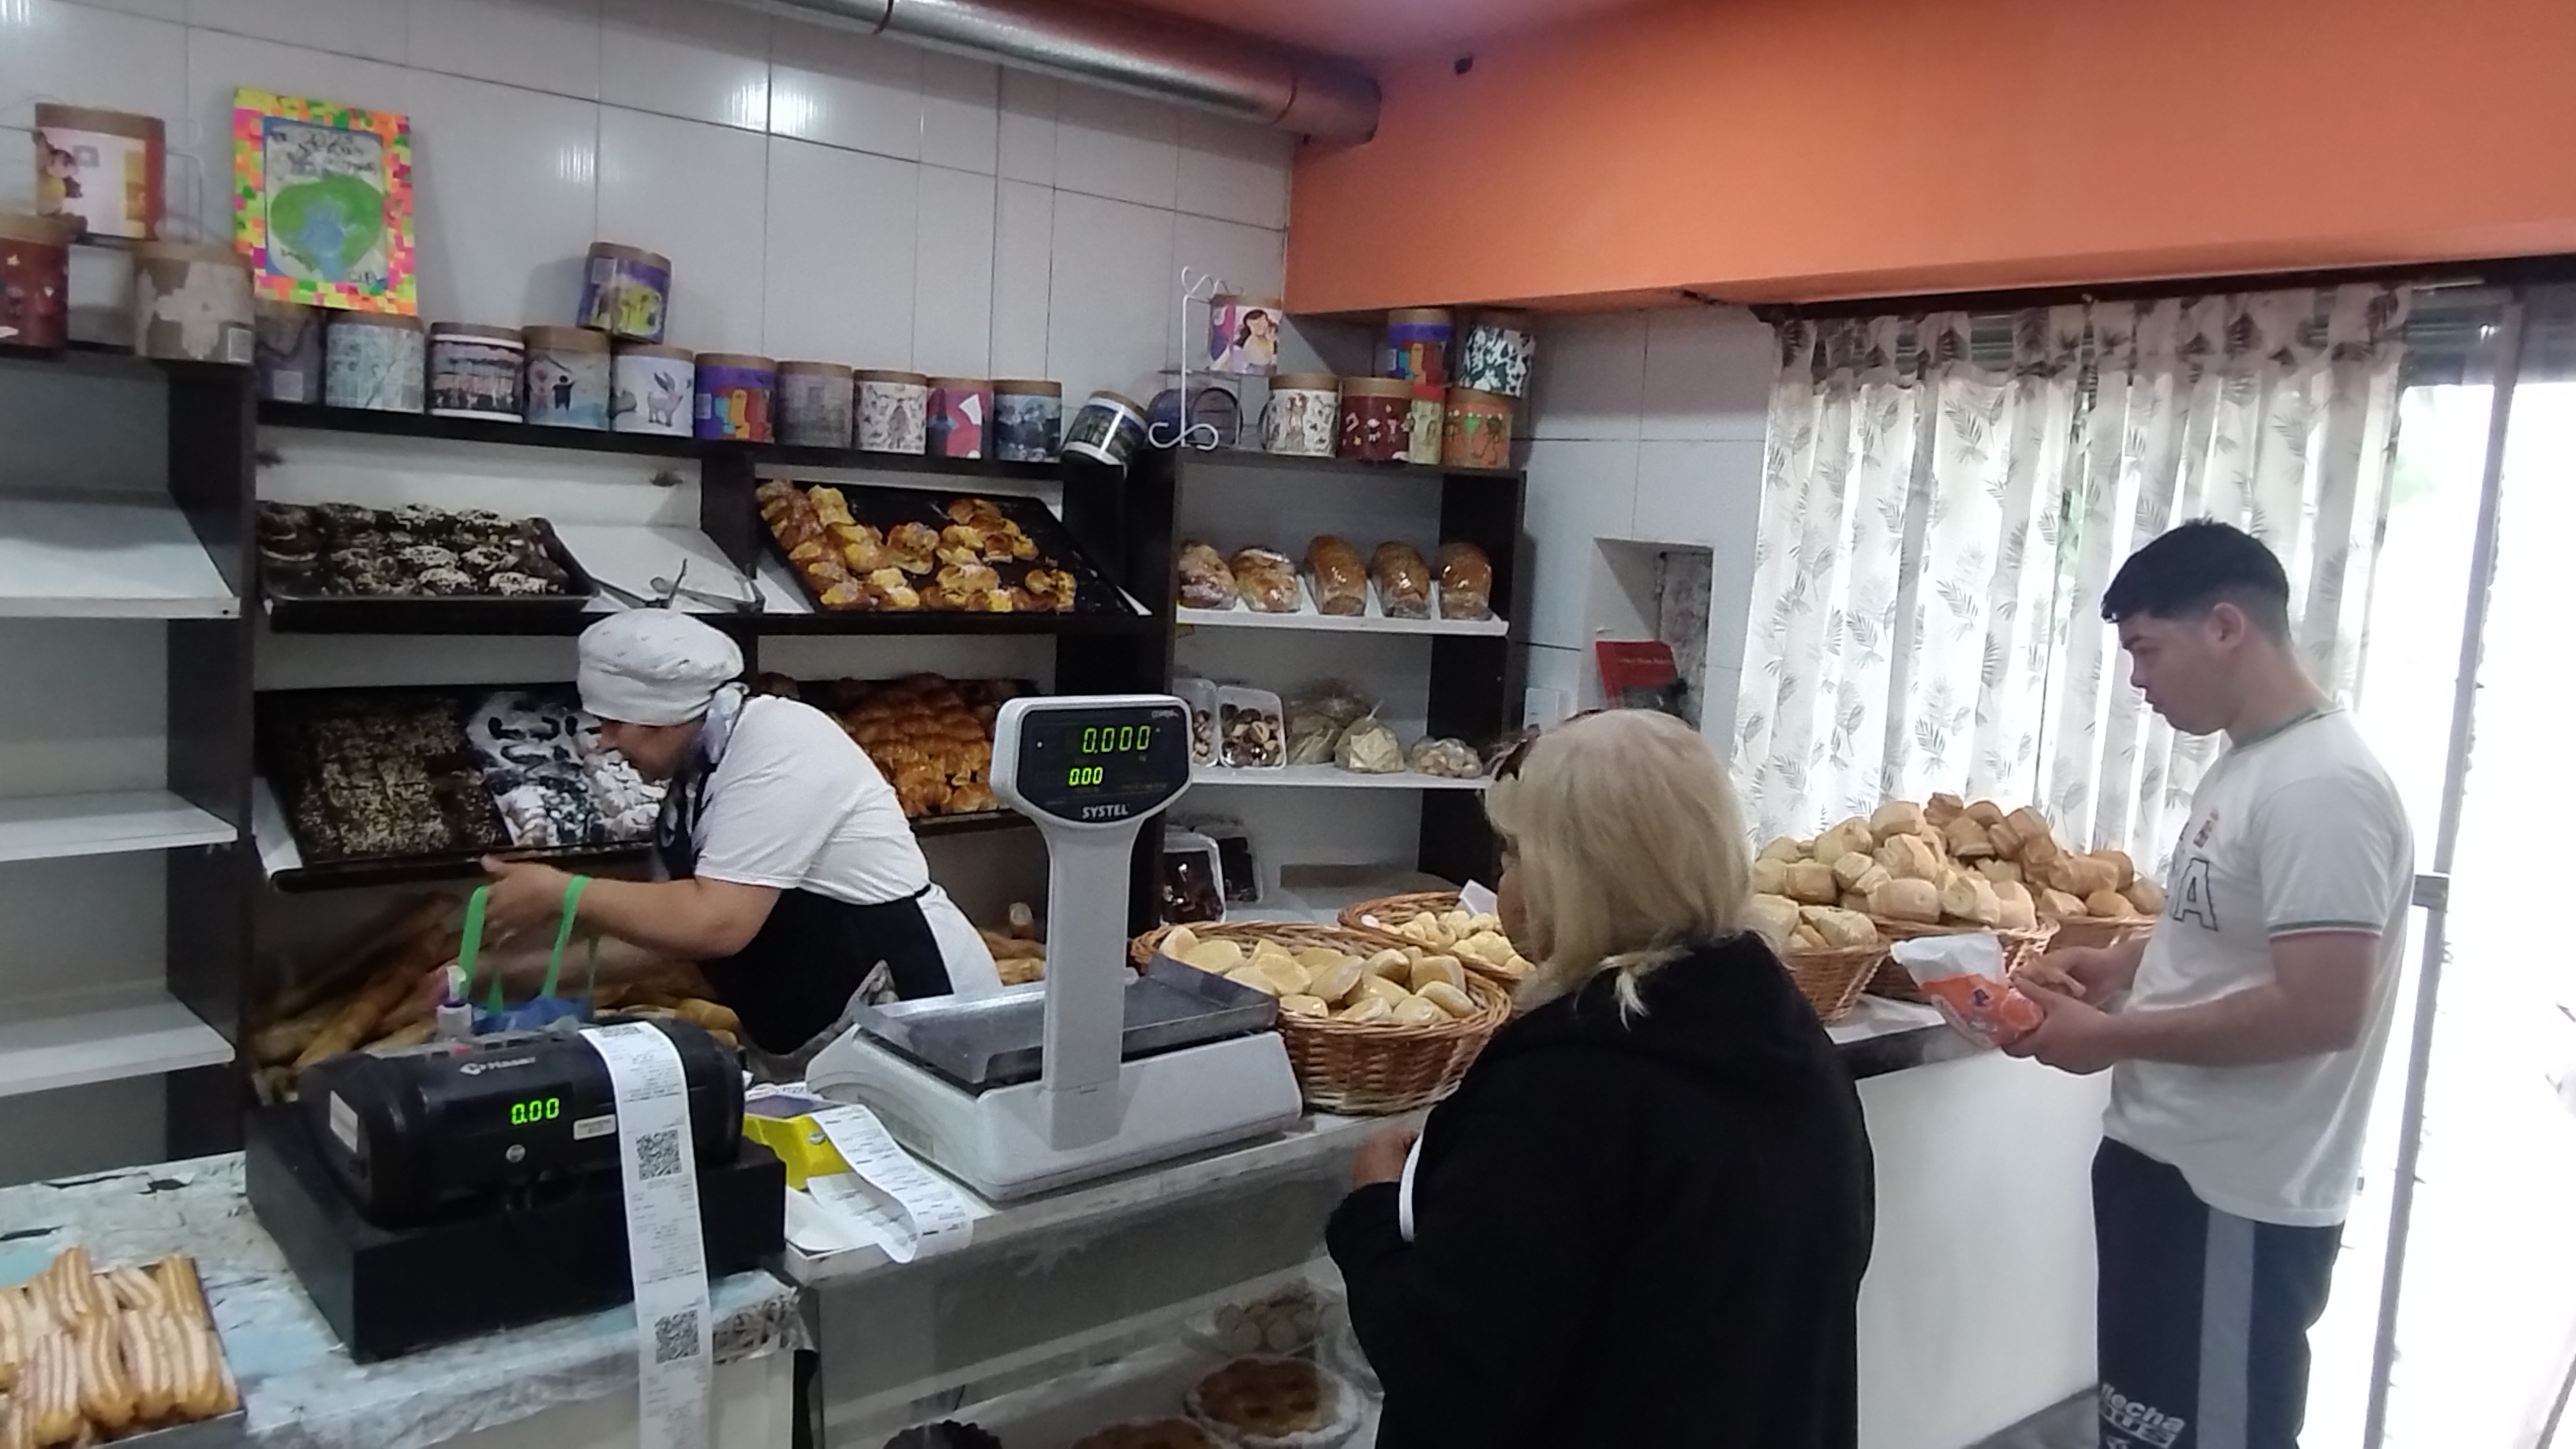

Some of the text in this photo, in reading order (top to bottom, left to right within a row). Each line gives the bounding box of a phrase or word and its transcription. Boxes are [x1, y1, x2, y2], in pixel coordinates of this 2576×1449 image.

[1082, 724, 1151, 754] 0.000
[1082, 804, 1129, 819] SYSTEL
[511, 1097, 560, 1125] 0.00
